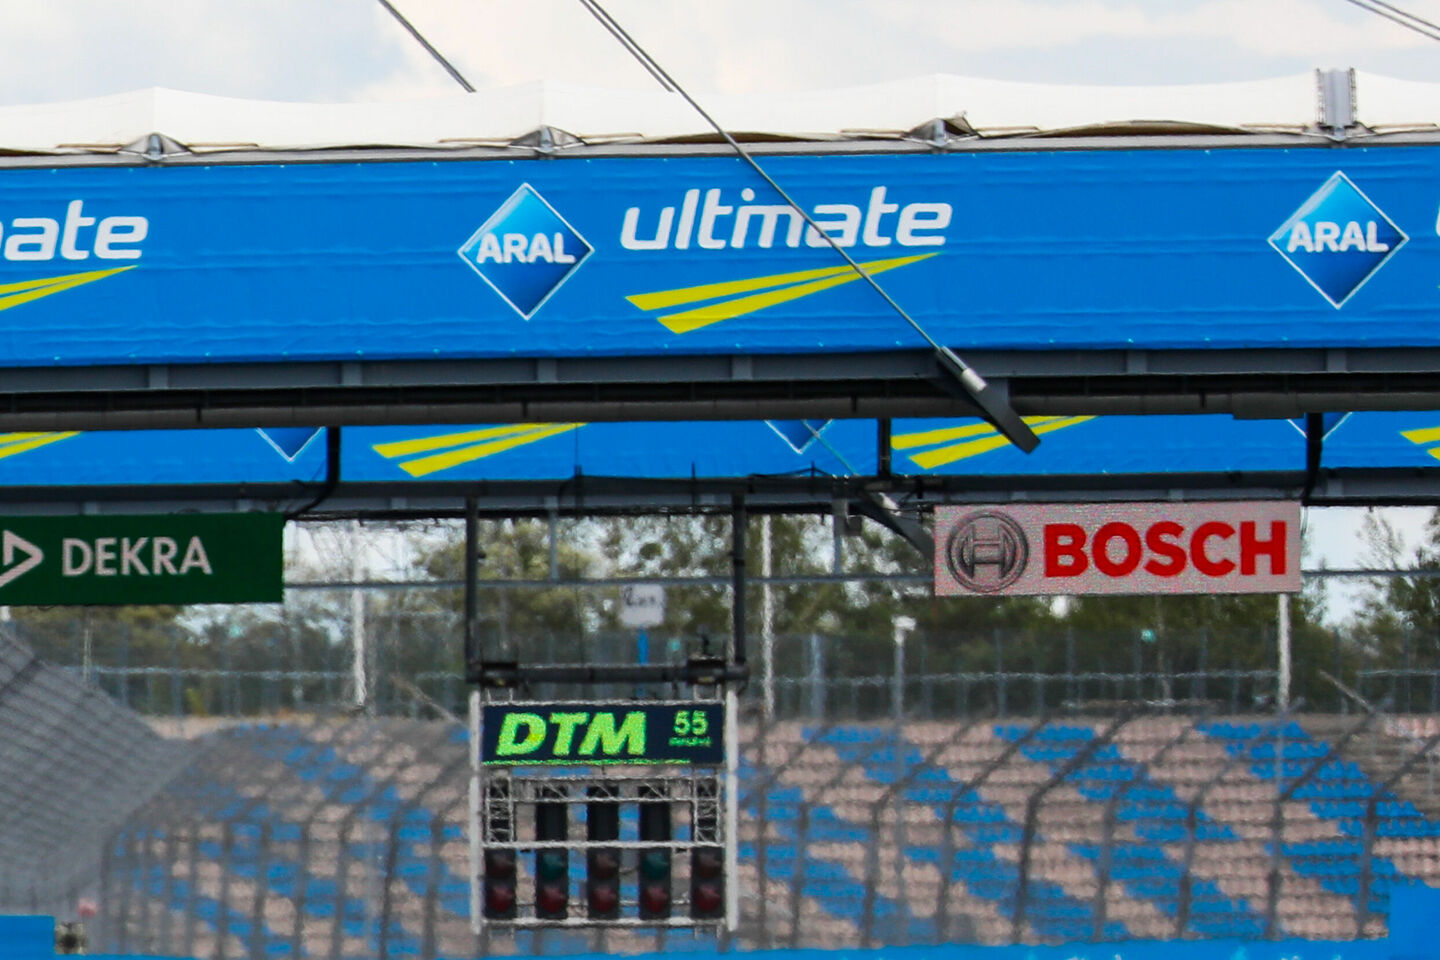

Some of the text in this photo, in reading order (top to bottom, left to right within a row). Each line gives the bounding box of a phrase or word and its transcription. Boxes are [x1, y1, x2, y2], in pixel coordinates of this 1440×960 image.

[476, 186, 953, 264] ARAL ultimate
[1287, 220, 1389, 252] ARAL
[62, 537, 212, 577] DEKRA
[1043, 520, 1287, 577] BOSCH
[495, 711, 646, 756] DTM
[674, 710, 708, 736] 55
